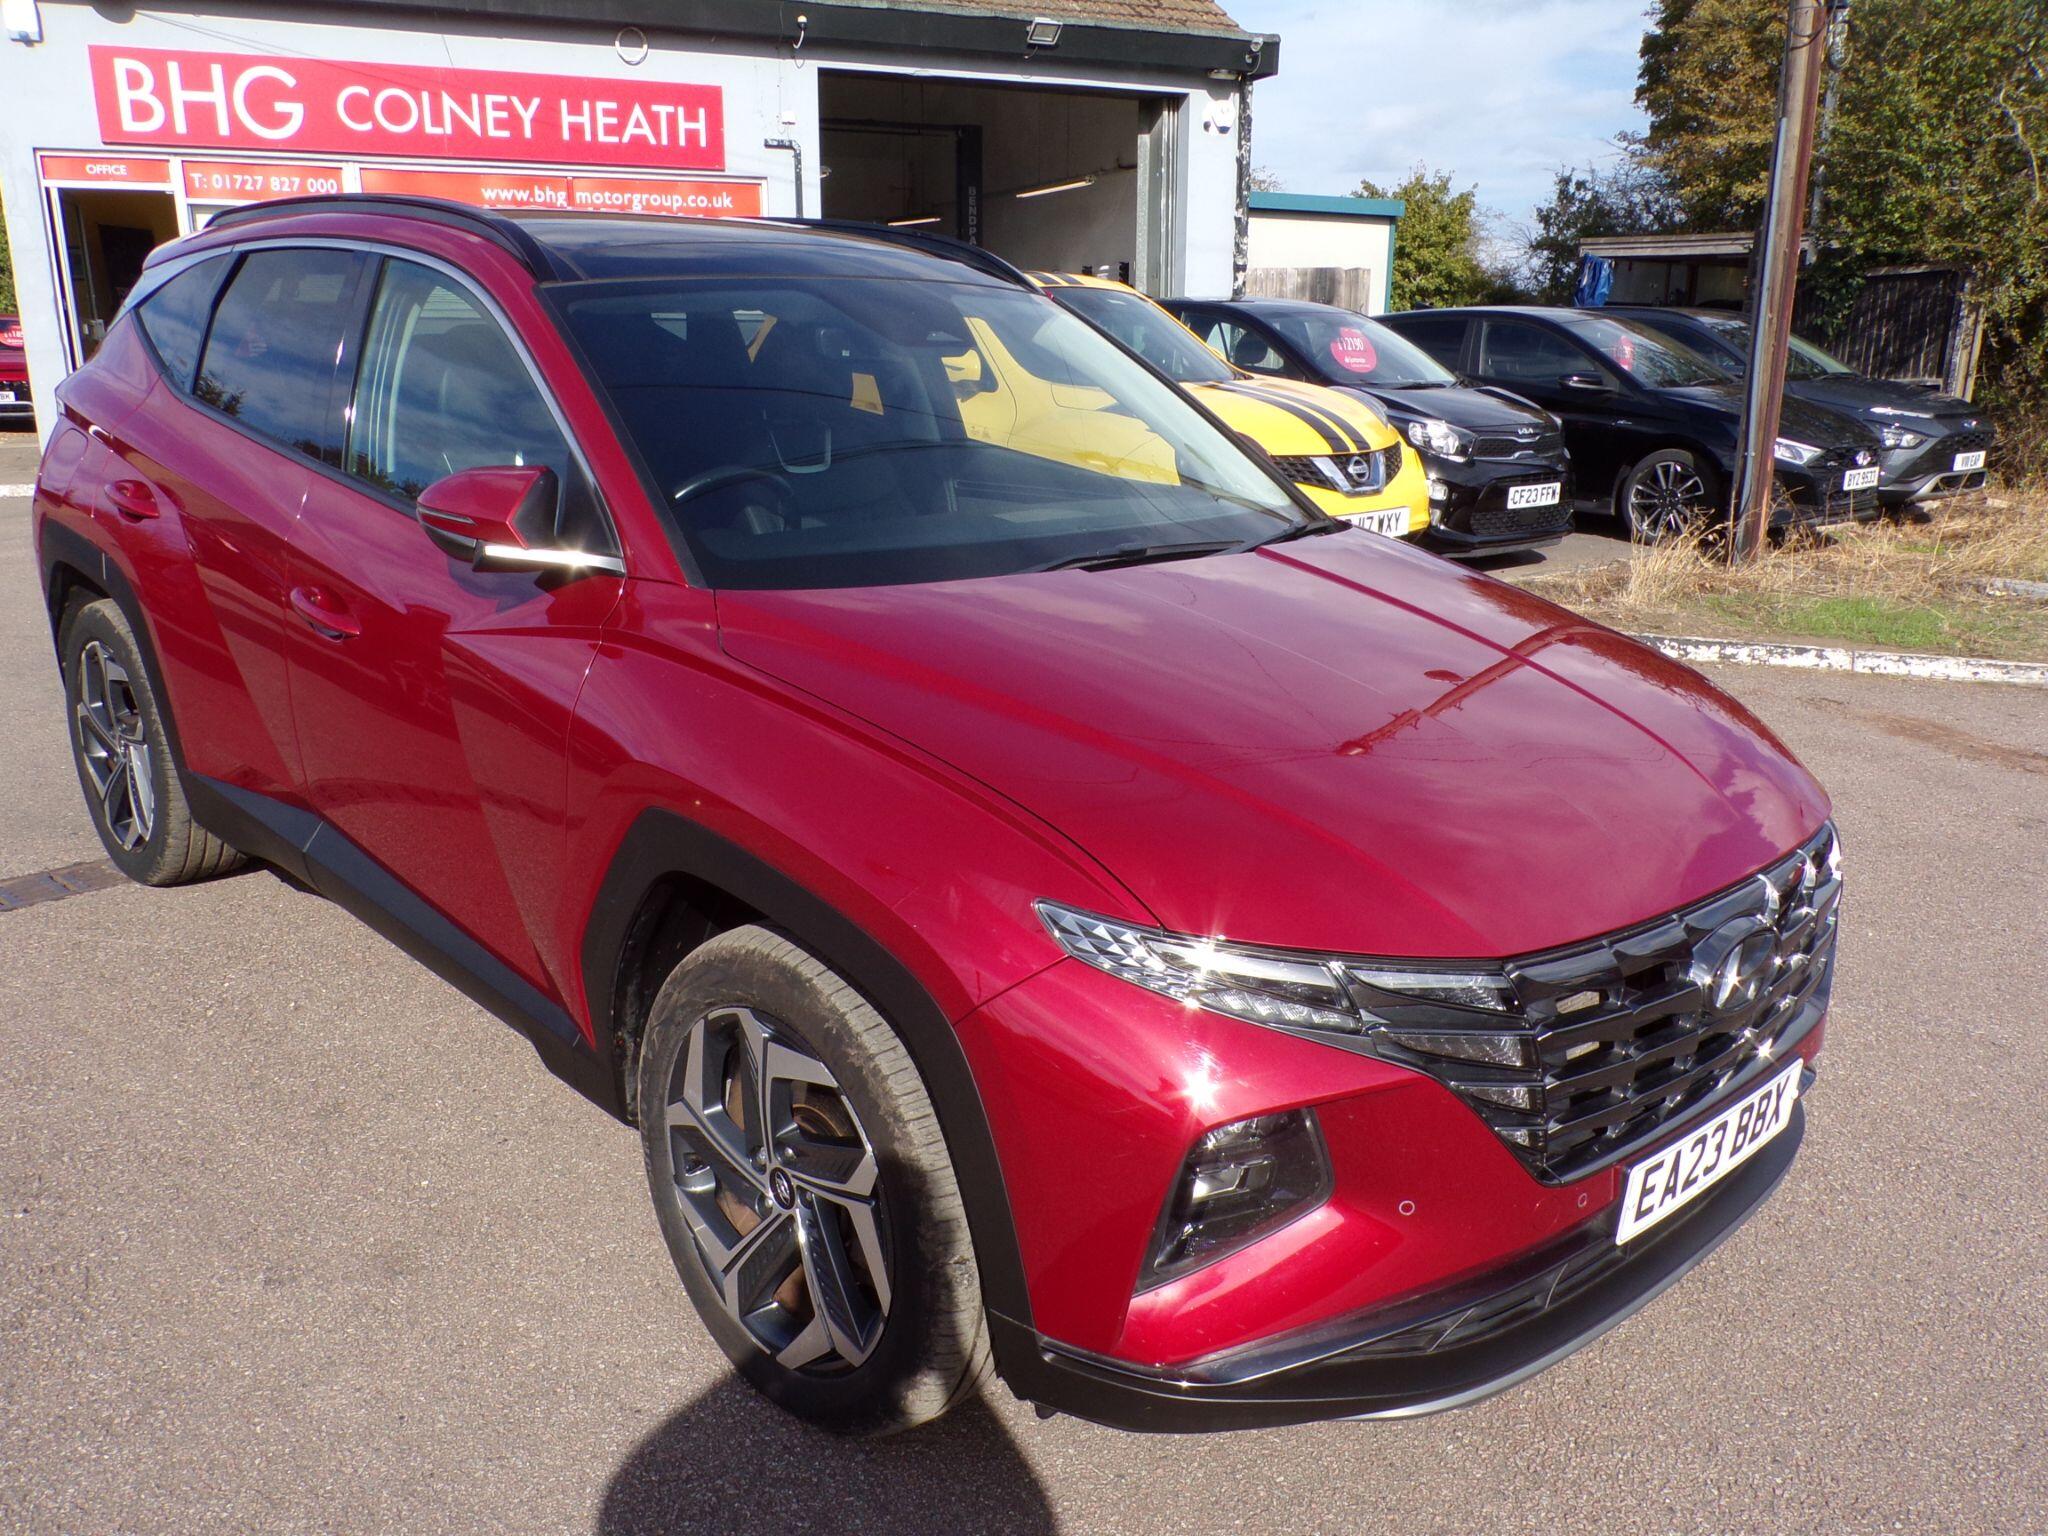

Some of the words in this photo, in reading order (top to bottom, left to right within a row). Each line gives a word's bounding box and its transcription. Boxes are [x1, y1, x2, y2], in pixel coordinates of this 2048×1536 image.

[113, 57, 304, 140] BHG
[336, 85, 541, 139] COLNEY
[560, 98, 707, 148] HEATH
[86, 164, 127, 176] OFFICE
[190, 172, 207, 189] T:
[212, 174, 263, 190] 01727
[270, 176, 300, 193] 827
[306, 178, 338, 195] 000
[575, 192, 733, 211] motorgroup.co.uk
[1512, 488, 1539, 505] CF23
[1634, 1120, 1729, 1223] EA23
[1729, 1074, 1791, 1160] BBX
